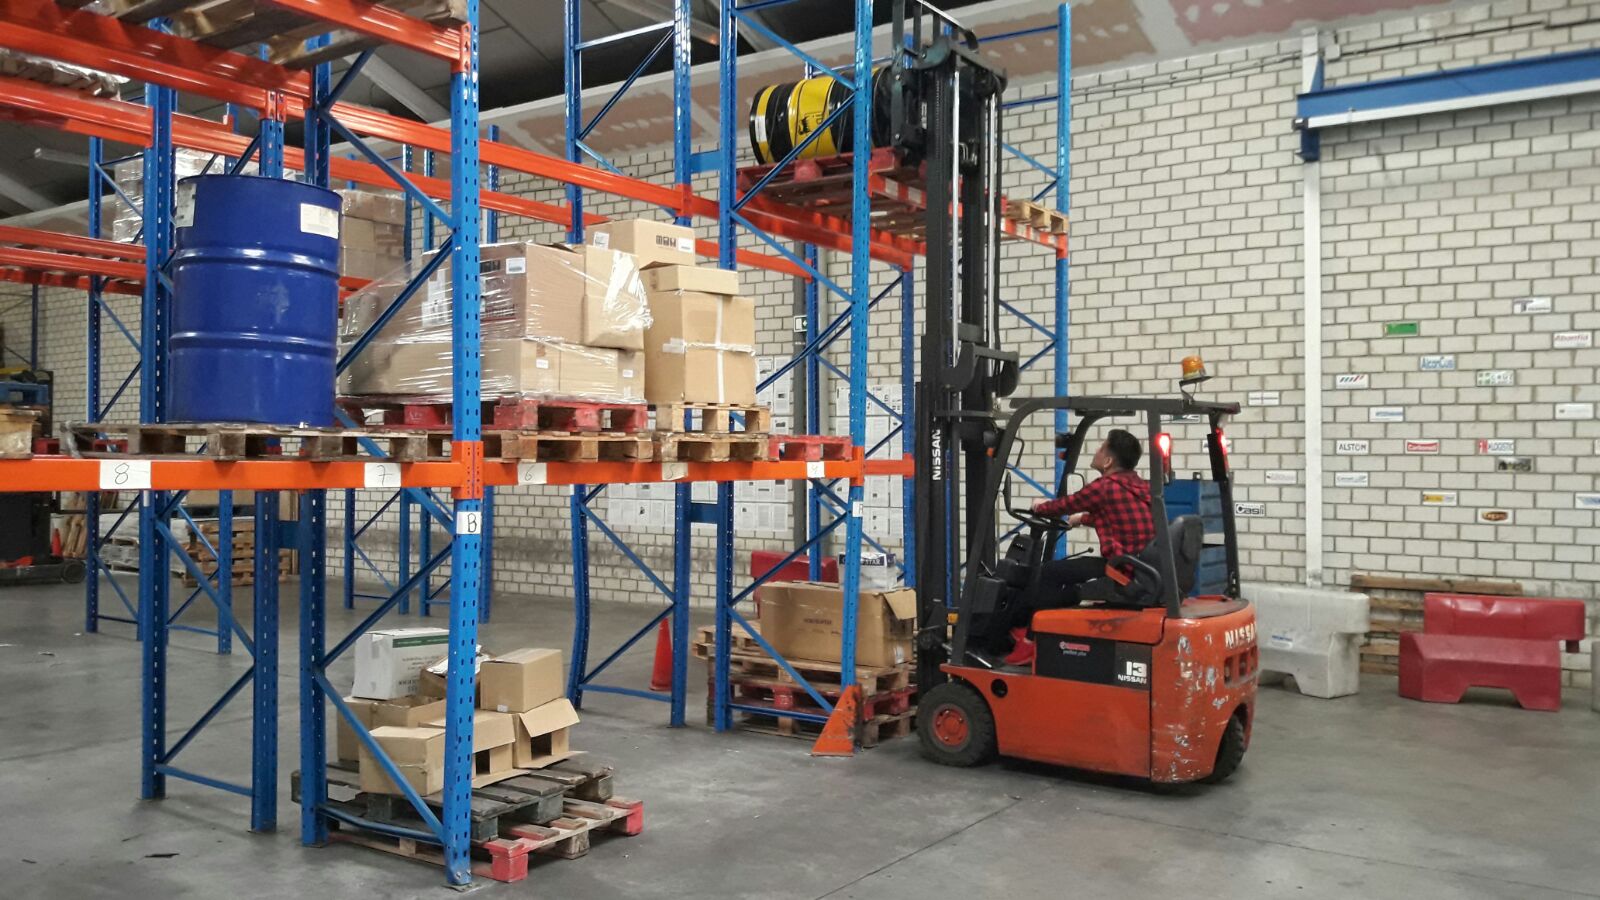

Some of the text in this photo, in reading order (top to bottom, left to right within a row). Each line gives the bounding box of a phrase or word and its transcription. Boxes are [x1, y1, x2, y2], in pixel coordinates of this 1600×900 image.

[932, 428, 941, 480] NISSAN
[114, 462, 130, 485] 8
[376, 464, 393, 486] 7
[524, 464, 536, 482] 6
[467, 513, 478, 533] B
[1117, 674, 1147, 685] NISSAN
[1126, 661, 1147, 678] 13
